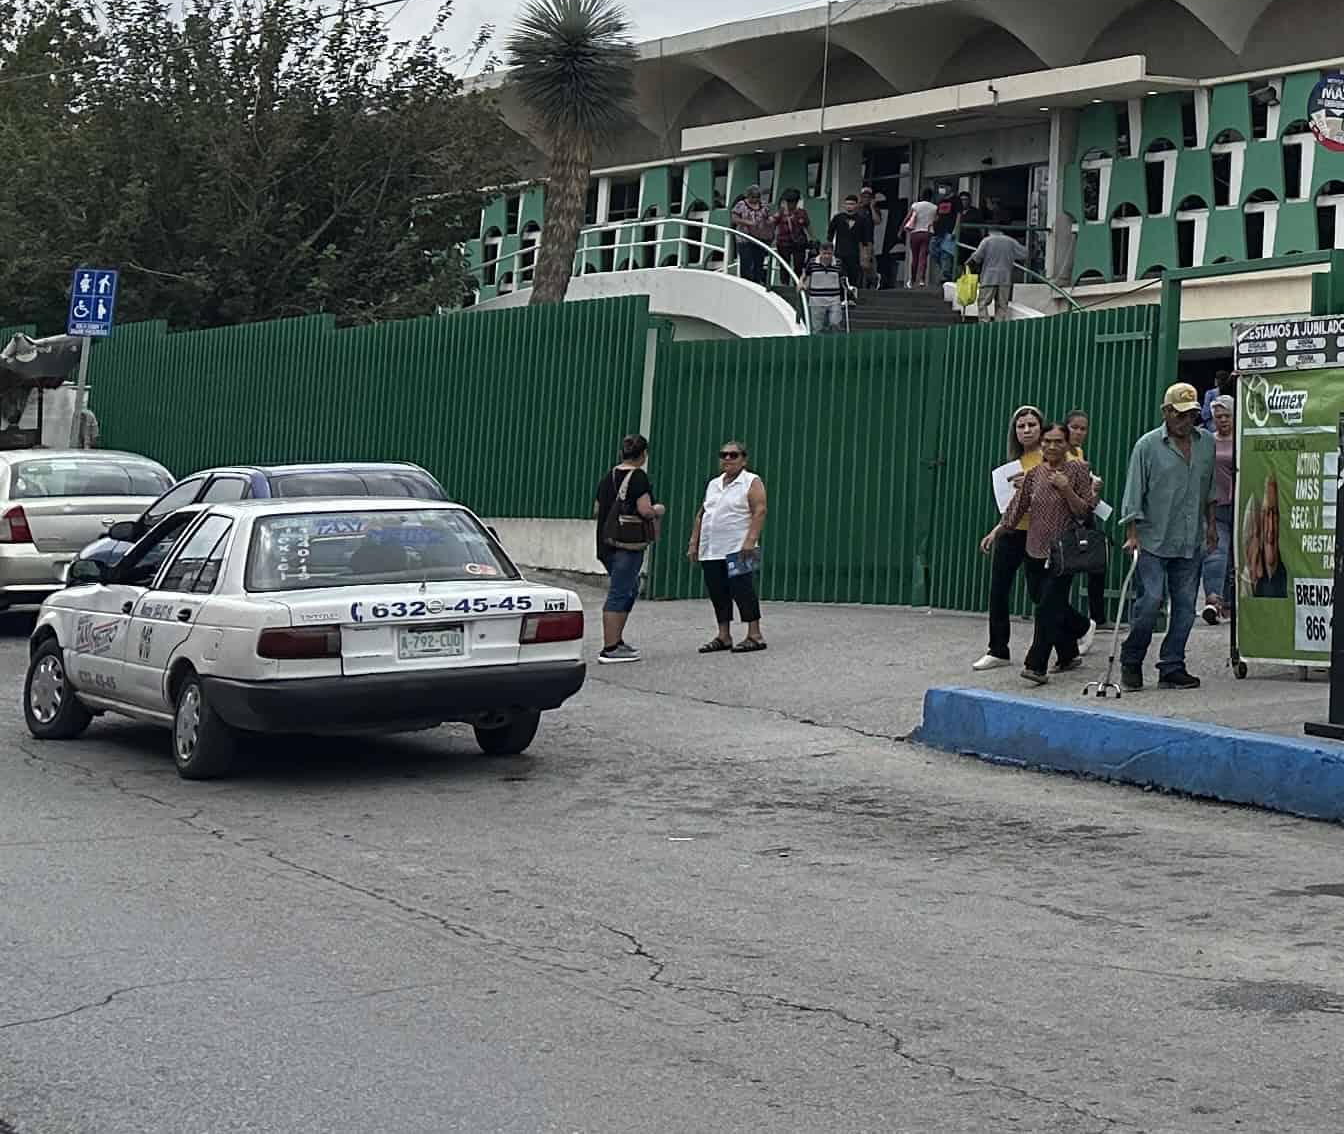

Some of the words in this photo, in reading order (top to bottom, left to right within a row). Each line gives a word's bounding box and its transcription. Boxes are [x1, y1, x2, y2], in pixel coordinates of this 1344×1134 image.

[1247, 324, 1291, 340] ESTAMOS
[1267, 384, 1304, 410] dimex
[1296, 451, 1320, 475] ACTIVOS
[1295, 478, 1320, 500] IMSS
[1301, 534, 1336, 554] PRESTA
[1305, 615, 1327, 641] 866
